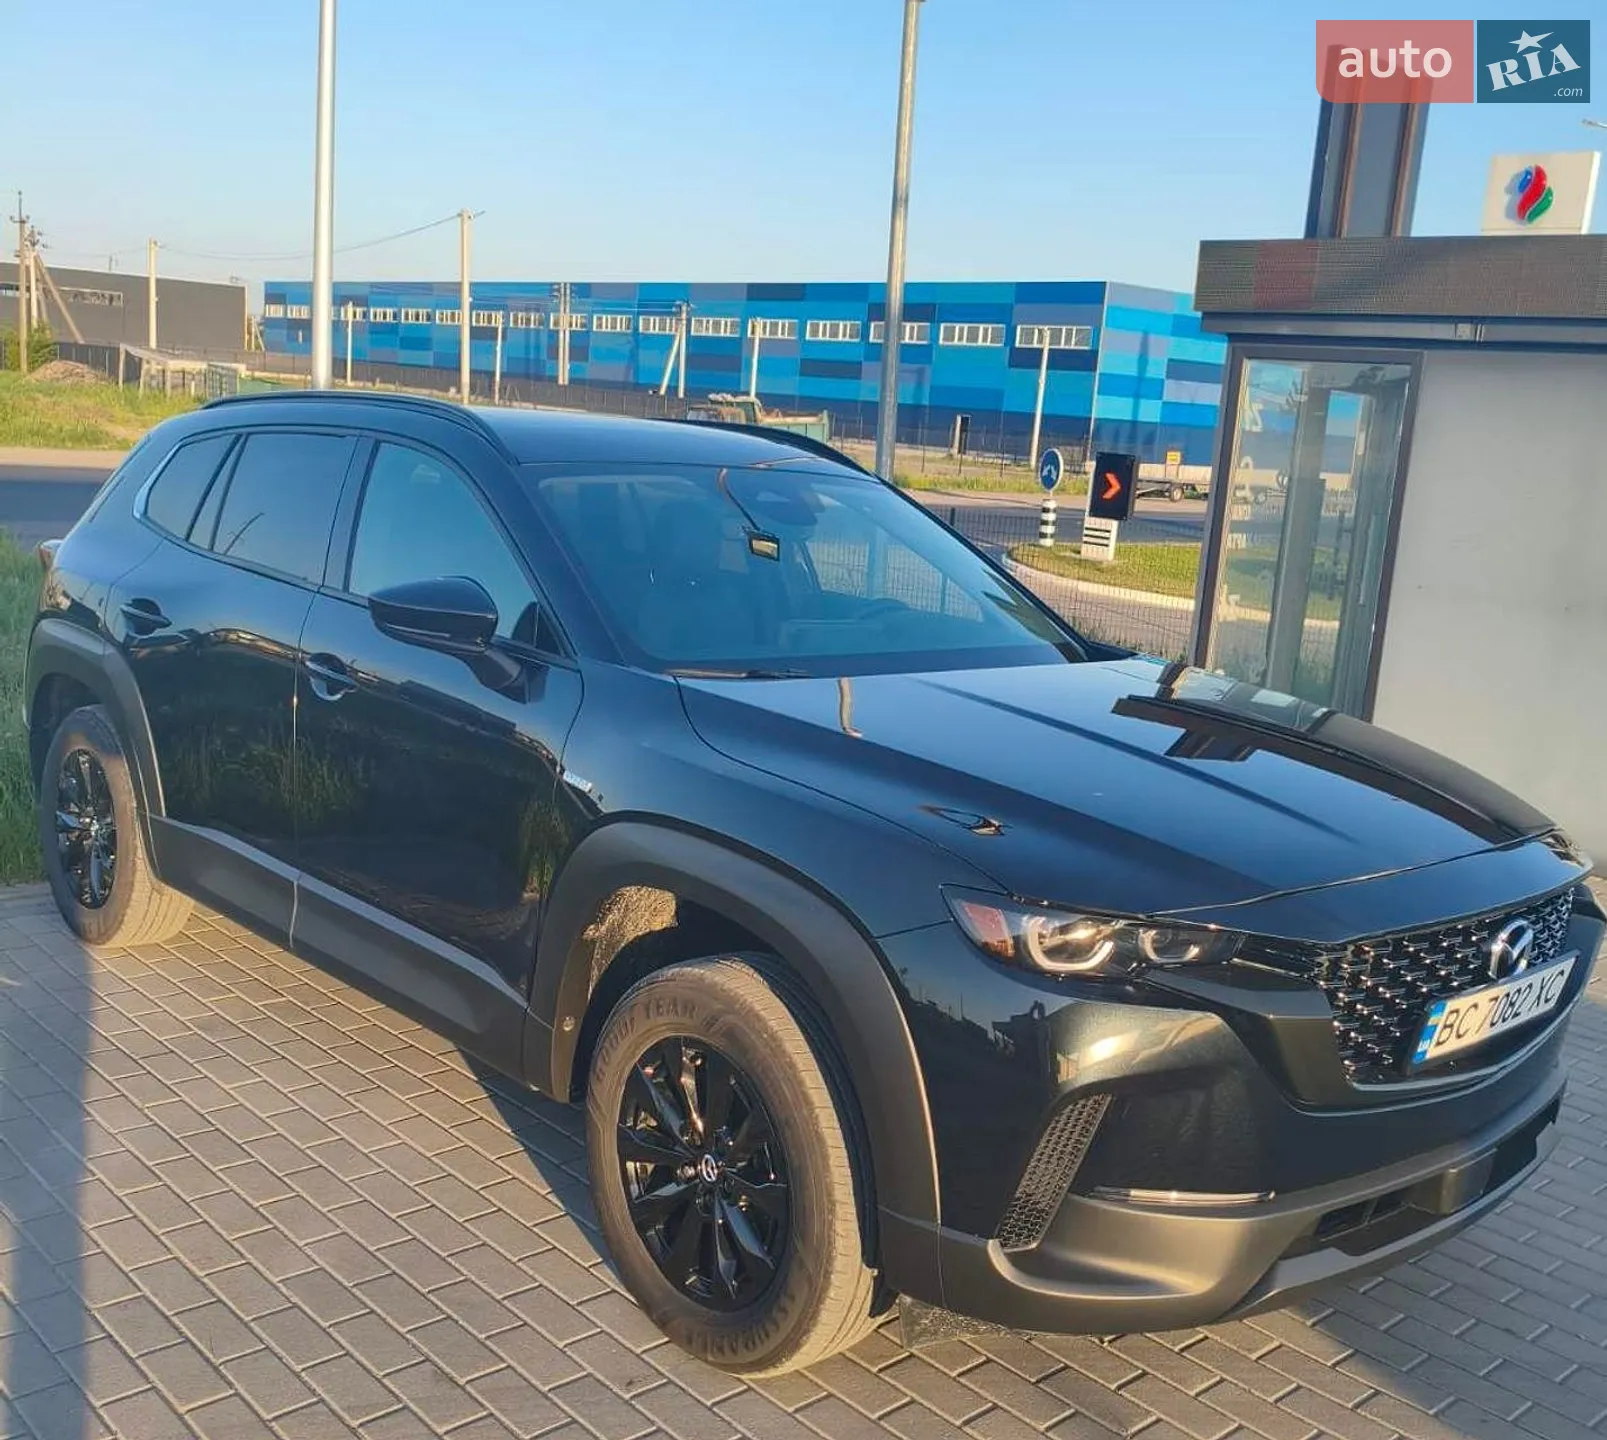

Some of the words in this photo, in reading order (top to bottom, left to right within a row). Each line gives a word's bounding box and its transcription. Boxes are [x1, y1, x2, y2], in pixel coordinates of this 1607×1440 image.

[1434, 1002, 1479, 1048] BC
[1474, 981, 1534, 1035] 7082
[1528, 968, 1565, 1013] XC
